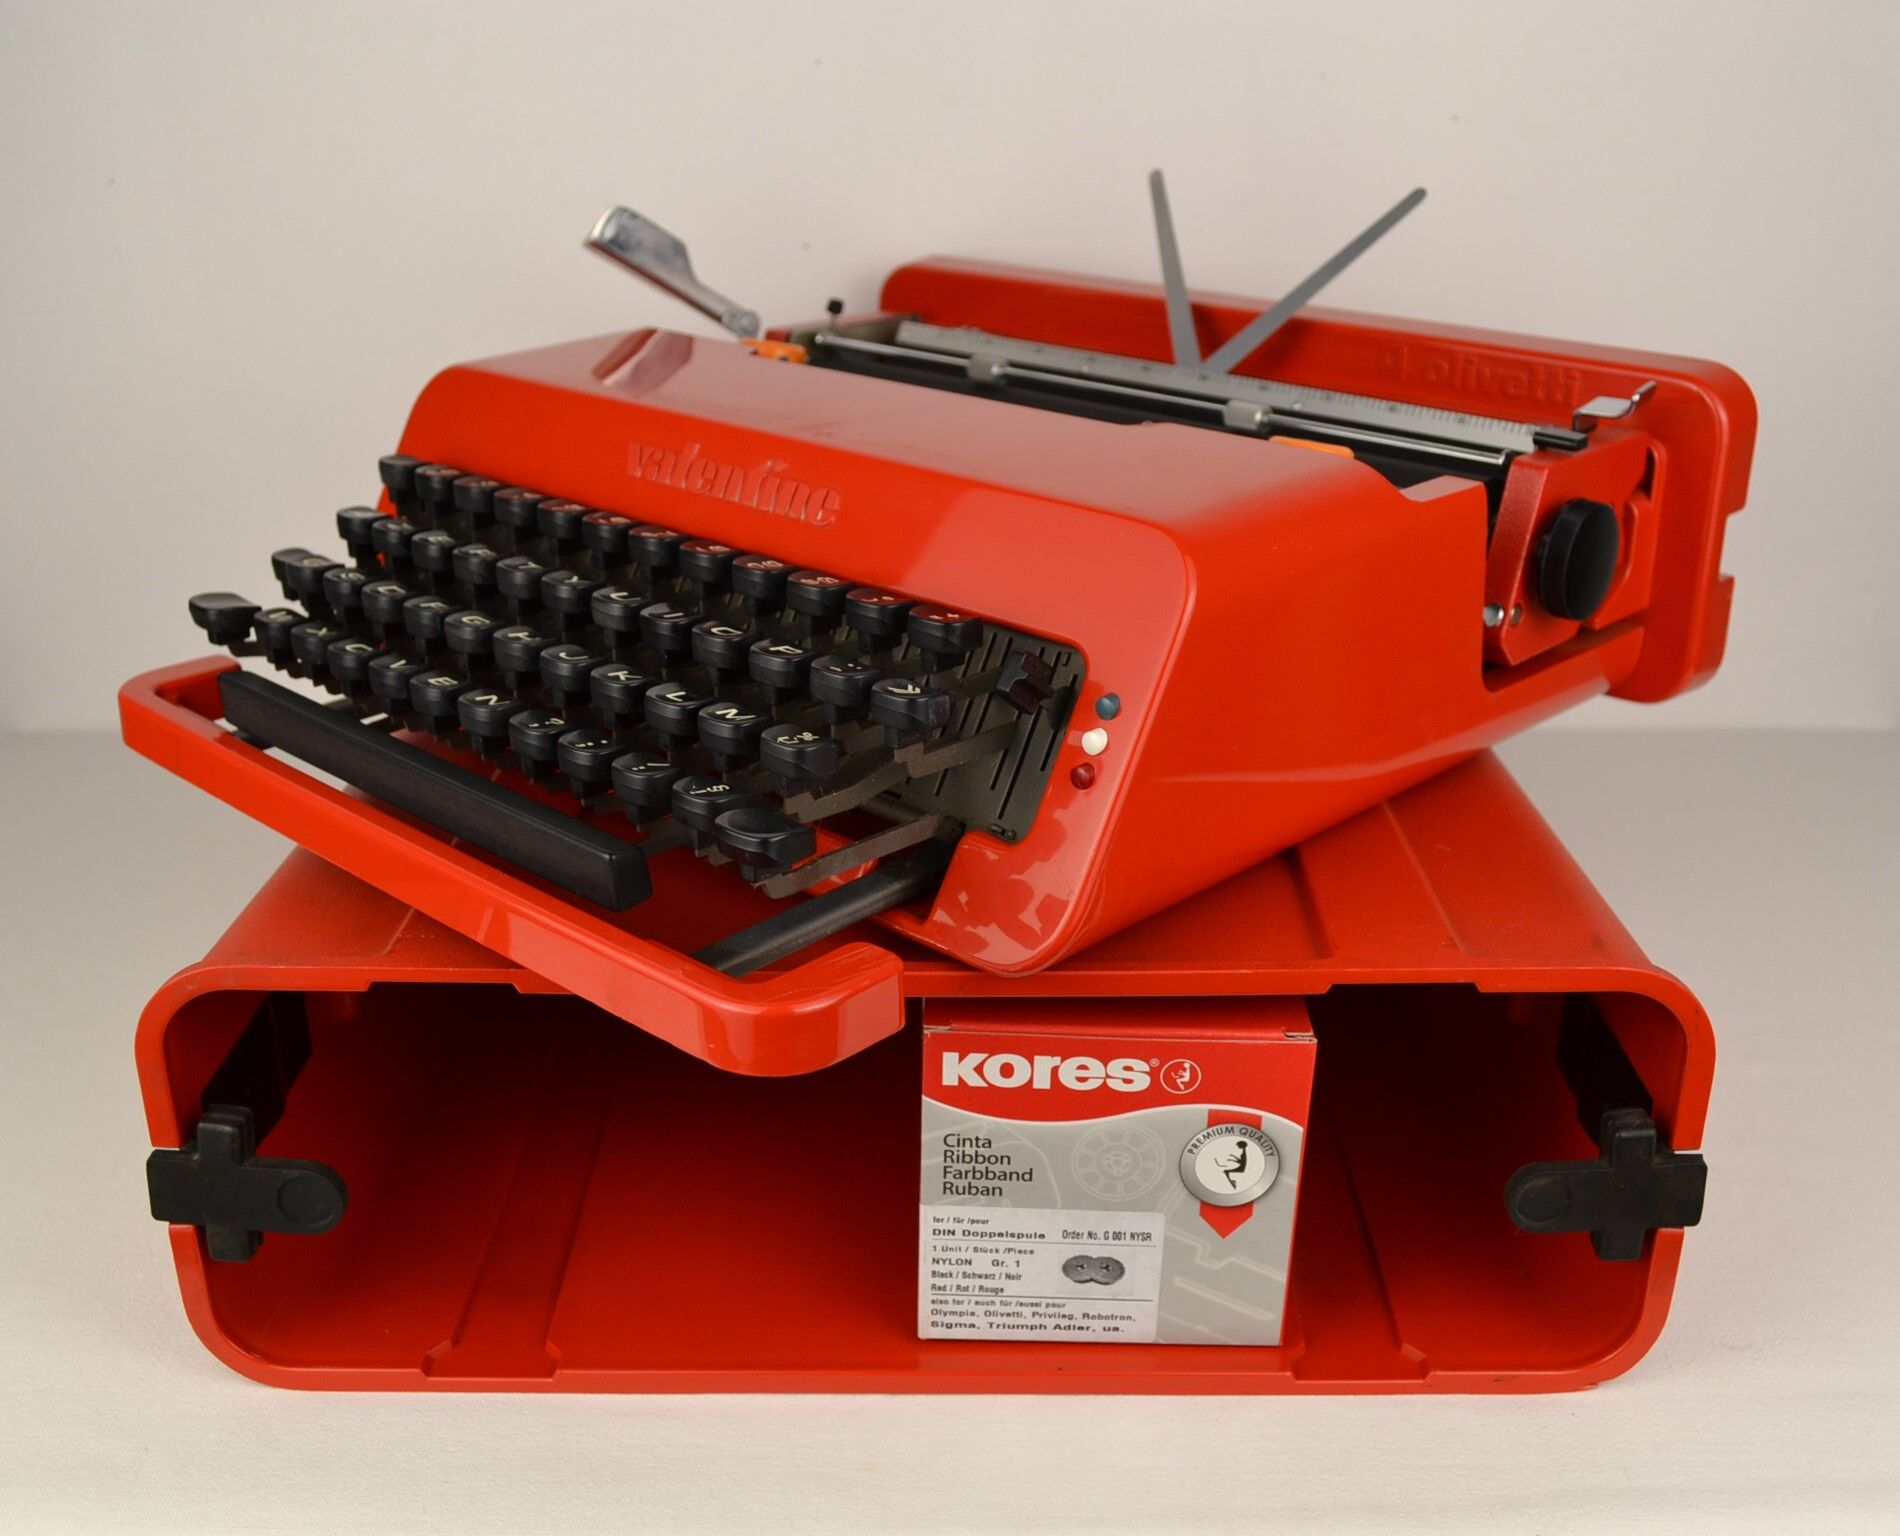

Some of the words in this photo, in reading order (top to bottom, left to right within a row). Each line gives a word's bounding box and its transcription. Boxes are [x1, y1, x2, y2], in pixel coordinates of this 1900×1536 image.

[627, 441, 841, 527] valentine
[942, 1052, 1151, 1092] Kores
[943, 1134, 992, 1149] Cinta
[1187, 1126, 1235, 1155] PREMIUM
[1239, 1127, 1276, 1158] QUALITY
[943, 1150, 1011, 1166] Ribbon
[943, 1166, 1034, 1182] Farbband
[943, 1182, 1003, 1197] Ruban
[932, 1216, 944, 1224] for
[953, 1216, 965, 1224] für
[932, 1228, 956, 1237] DIN
[962, 1229, 1046, 1240] Doppelspule
[1062, 1229, 1085, 1240] Order
[1087, 1231, 1101, 1240] No.
[1104, 1231, 1110, 1241] G
[1112, 1231, 1127, 1241] 001
[1130, 1232, 1152, 1242] NYSR
[941, 1245, 962, 1253] Unit
[973, 1246, 1000, 1254] Stück
[931, 1258, 973, 1267] NYLON
[991, 1259, 1009, 1267] Gr.
[931, 1270, 953, 1279] Black
[962, 1271, 996, 1280] Schwarz
[1005, 1272, 1023, 1281] Noir
[931, 1284, 947, 1292] Red
[956, 1285, 970, 1293] Rot
[978, 1285, 1005, 1296] Rouge
[931, 1298, 950, 1306] also
[1000, 1300, 1012, 1308] für
[1045, 1302, 1066, 1310] pour
[931, 1309, 980, 1319] Olympia,
[983, 1310, 1028, 1320] Olivetti,
[1031, 1311, 1078, 1321] Privileg,
[1082, 1312, 1136, 1322] Robotron,
[931, 1321, 981, 1331] Sigma,
[988, 1322, 1047, 1332] Triumph
[1053, 1323, 1096, 1333] Adler,
